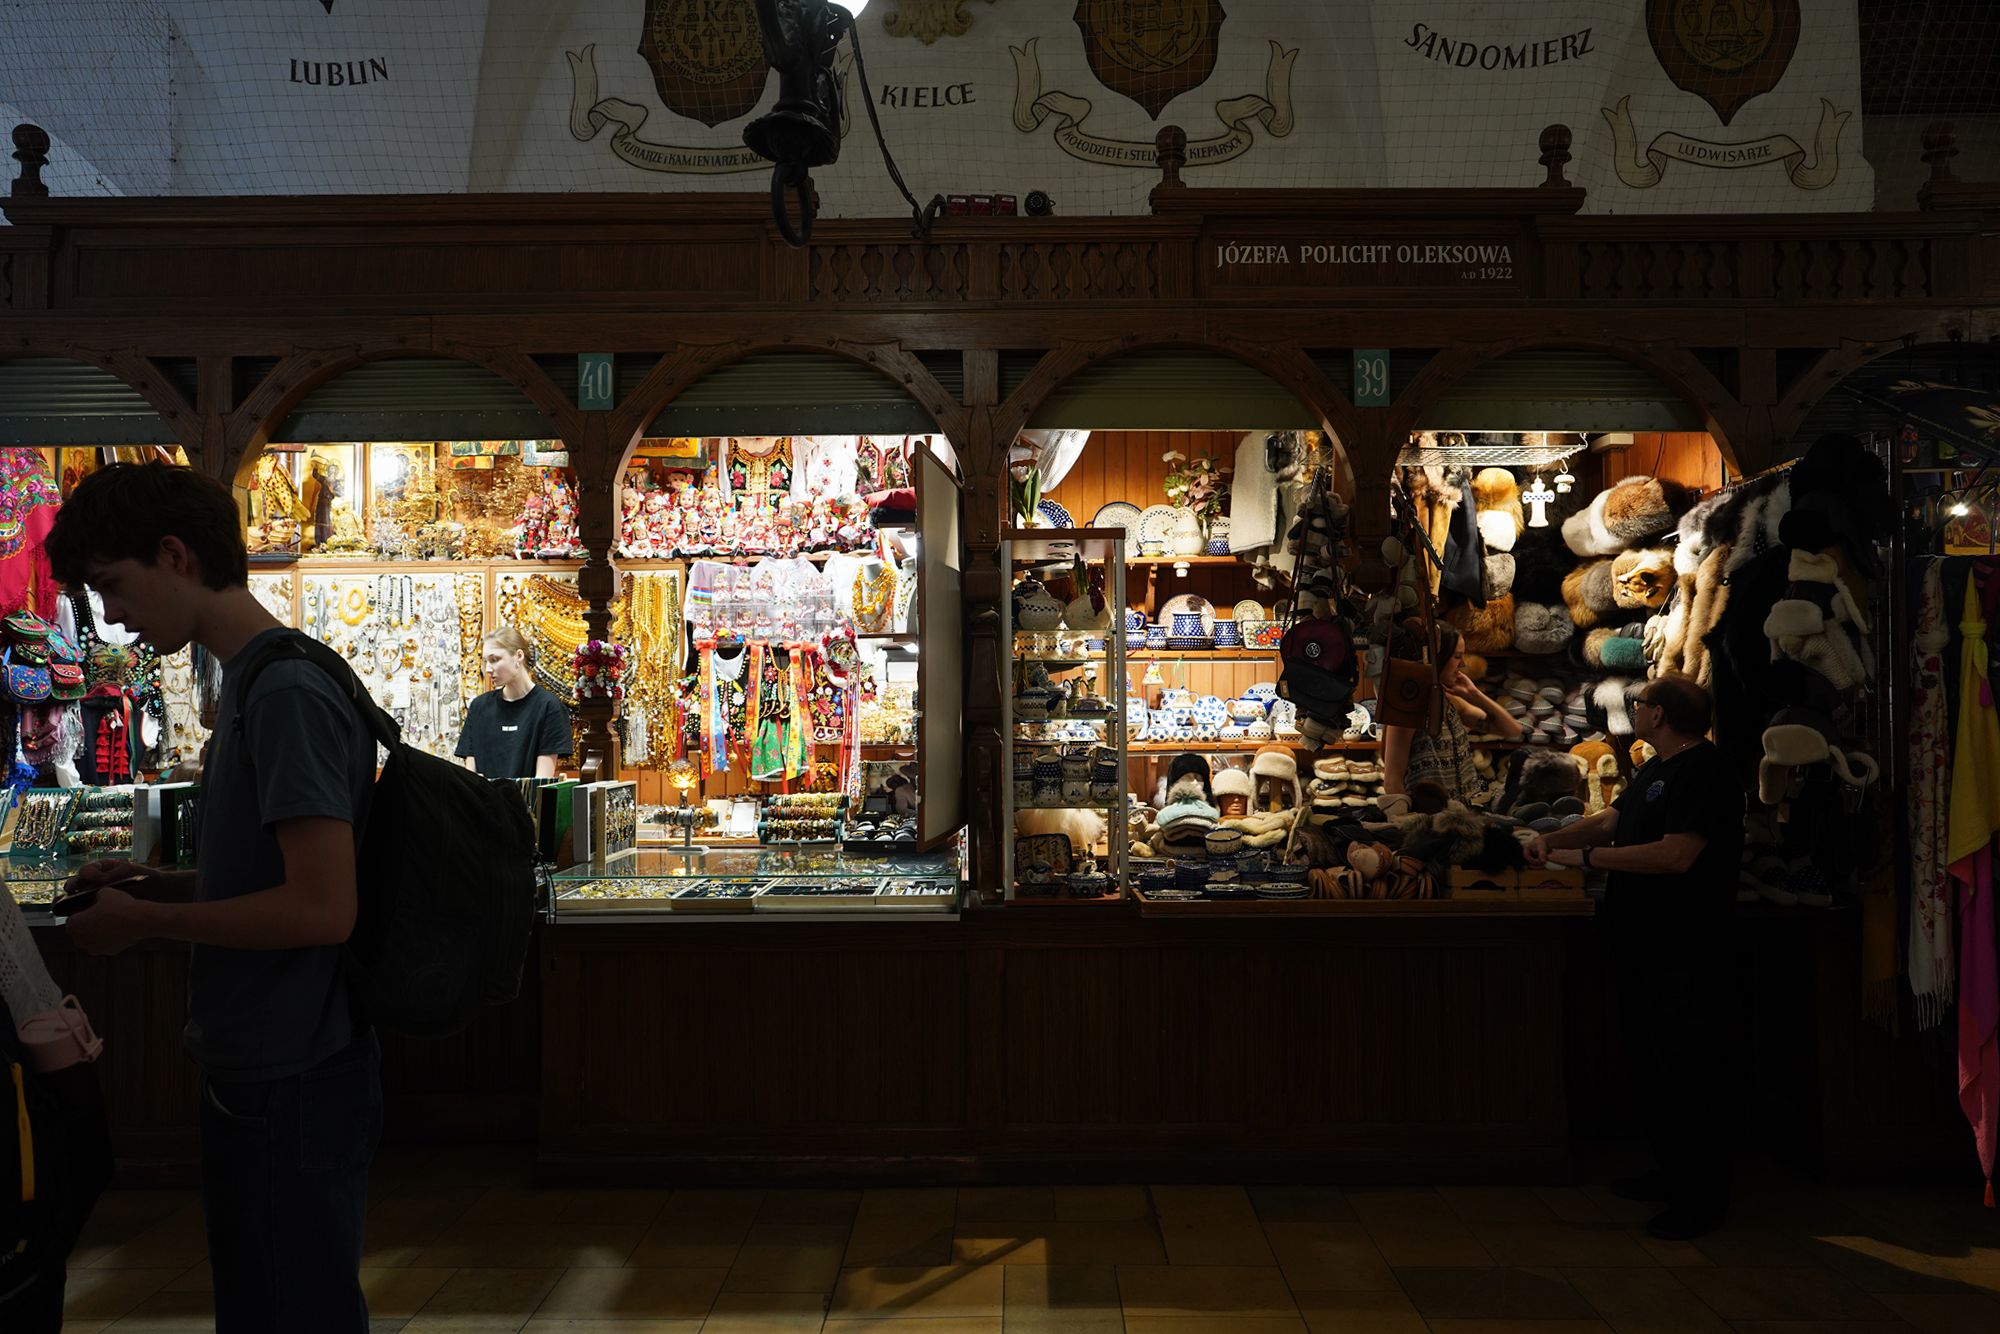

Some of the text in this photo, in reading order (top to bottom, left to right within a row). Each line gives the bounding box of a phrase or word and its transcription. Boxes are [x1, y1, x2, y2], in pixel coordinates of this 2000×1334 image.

[1404, 23, 1595, 70] SANDOMIERZ
[289, 57, 388, 86] LUBLIN
[880, 82, 976, 109] KIELCE
[1678, 142, 1772, 162] LUDWISARZE
[1217, 241, 1513, 269] JÓZEFA POLICHT OLEKSOWA
[1480, 267, 1513, 279] 1922
[580, 361, 613, 400] 40
[1357, 358, 1387, 397] 39
